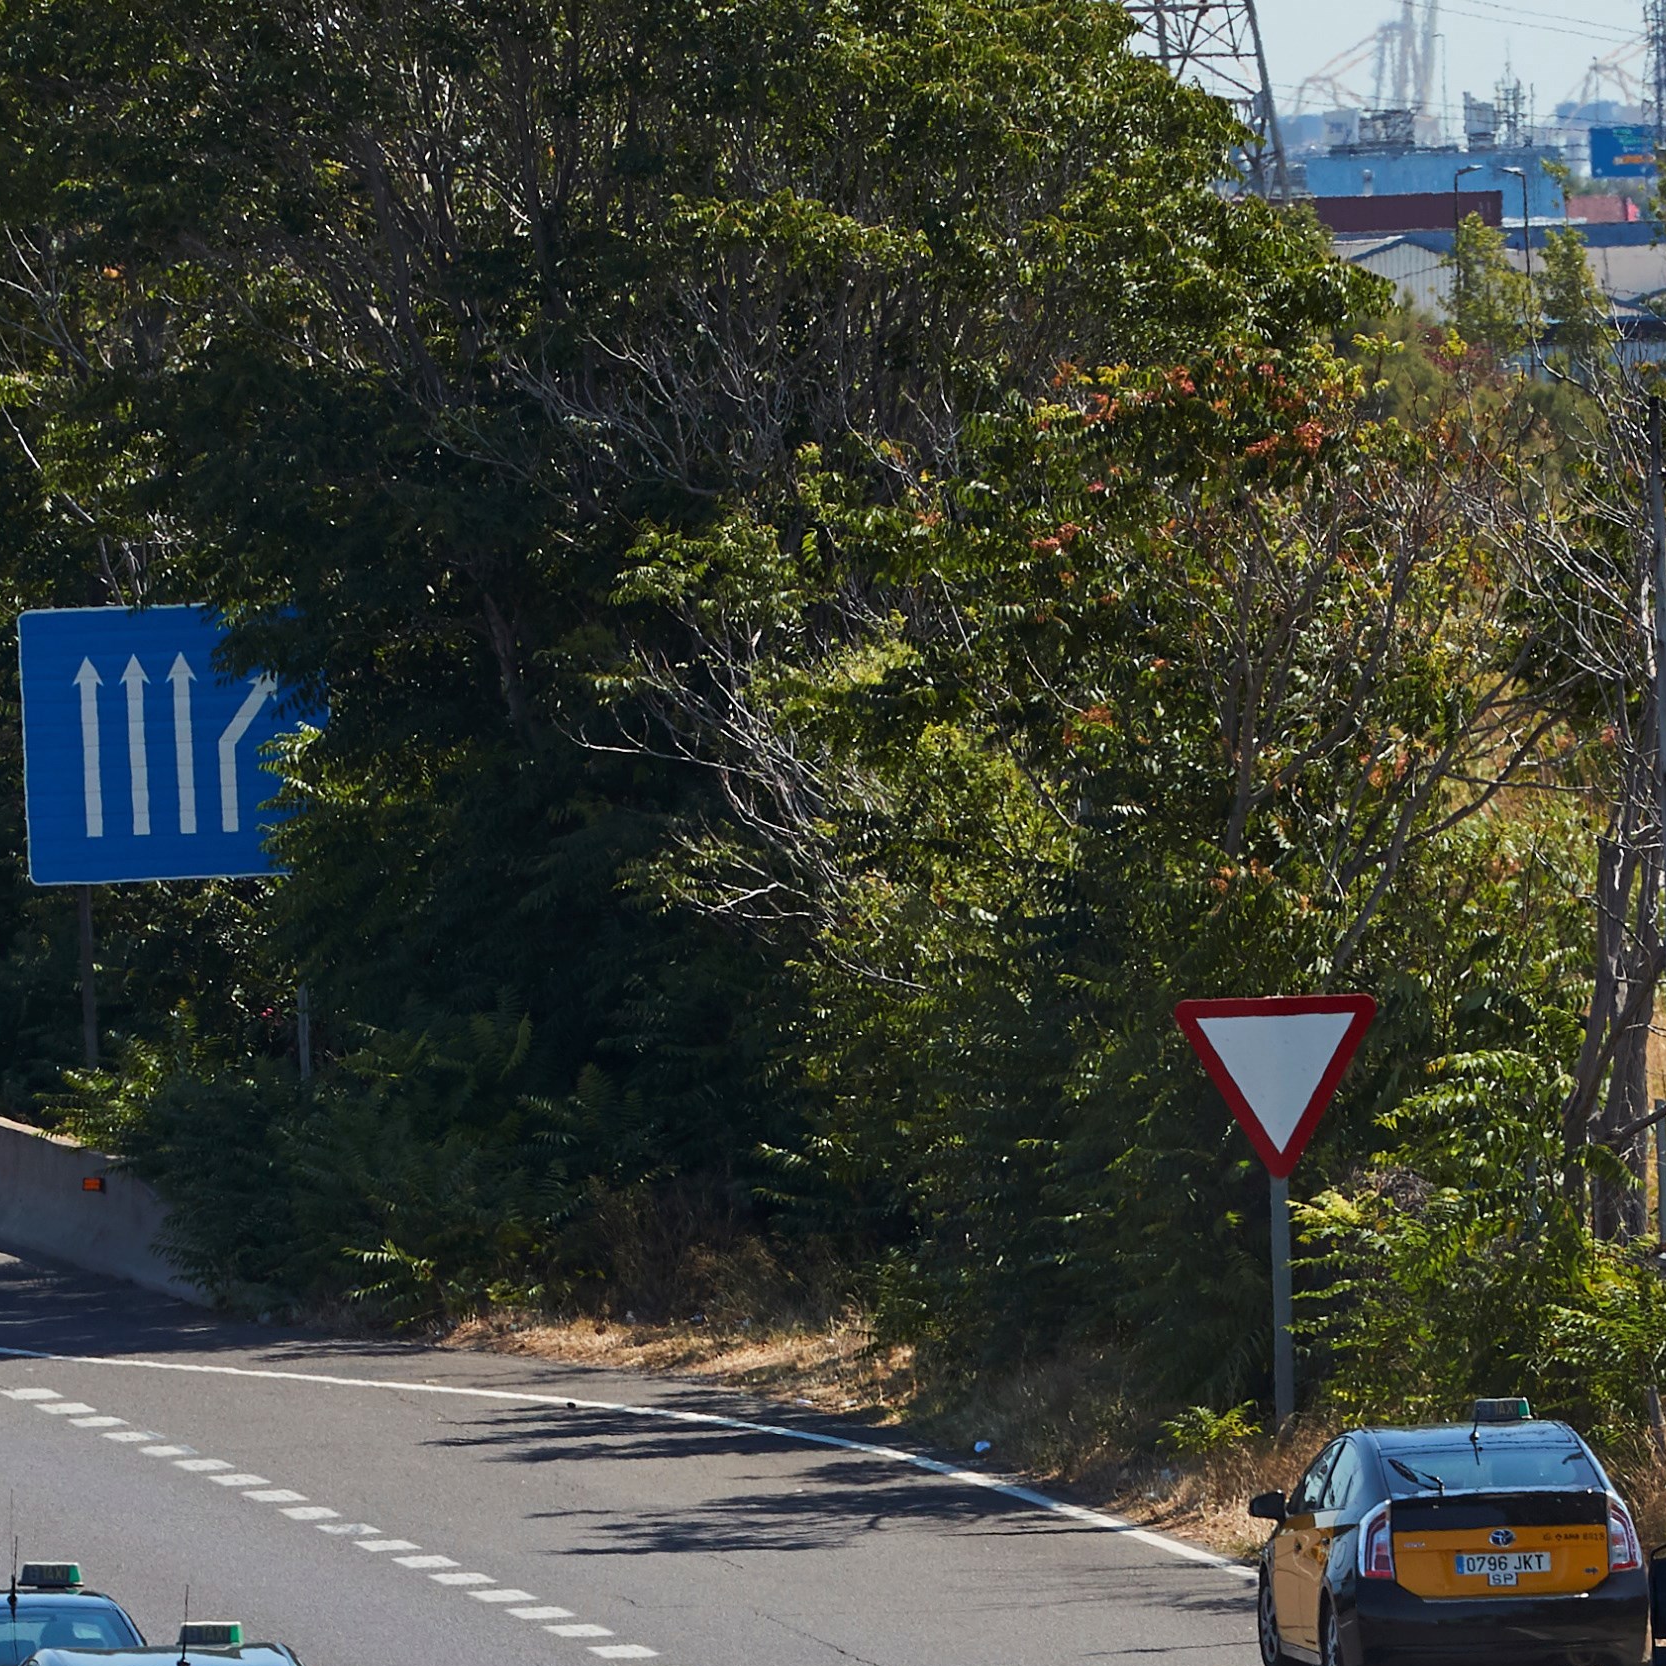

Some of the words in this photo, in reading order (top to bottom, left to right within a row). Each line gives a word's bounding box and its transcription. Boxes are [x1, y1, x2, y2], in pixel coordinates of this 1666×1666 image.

[1466, 1556, 1508, 1572] 0796
[1513, 1554, 1544, 1571] JKT
[1491, 1573, 1514, 1585] SP
